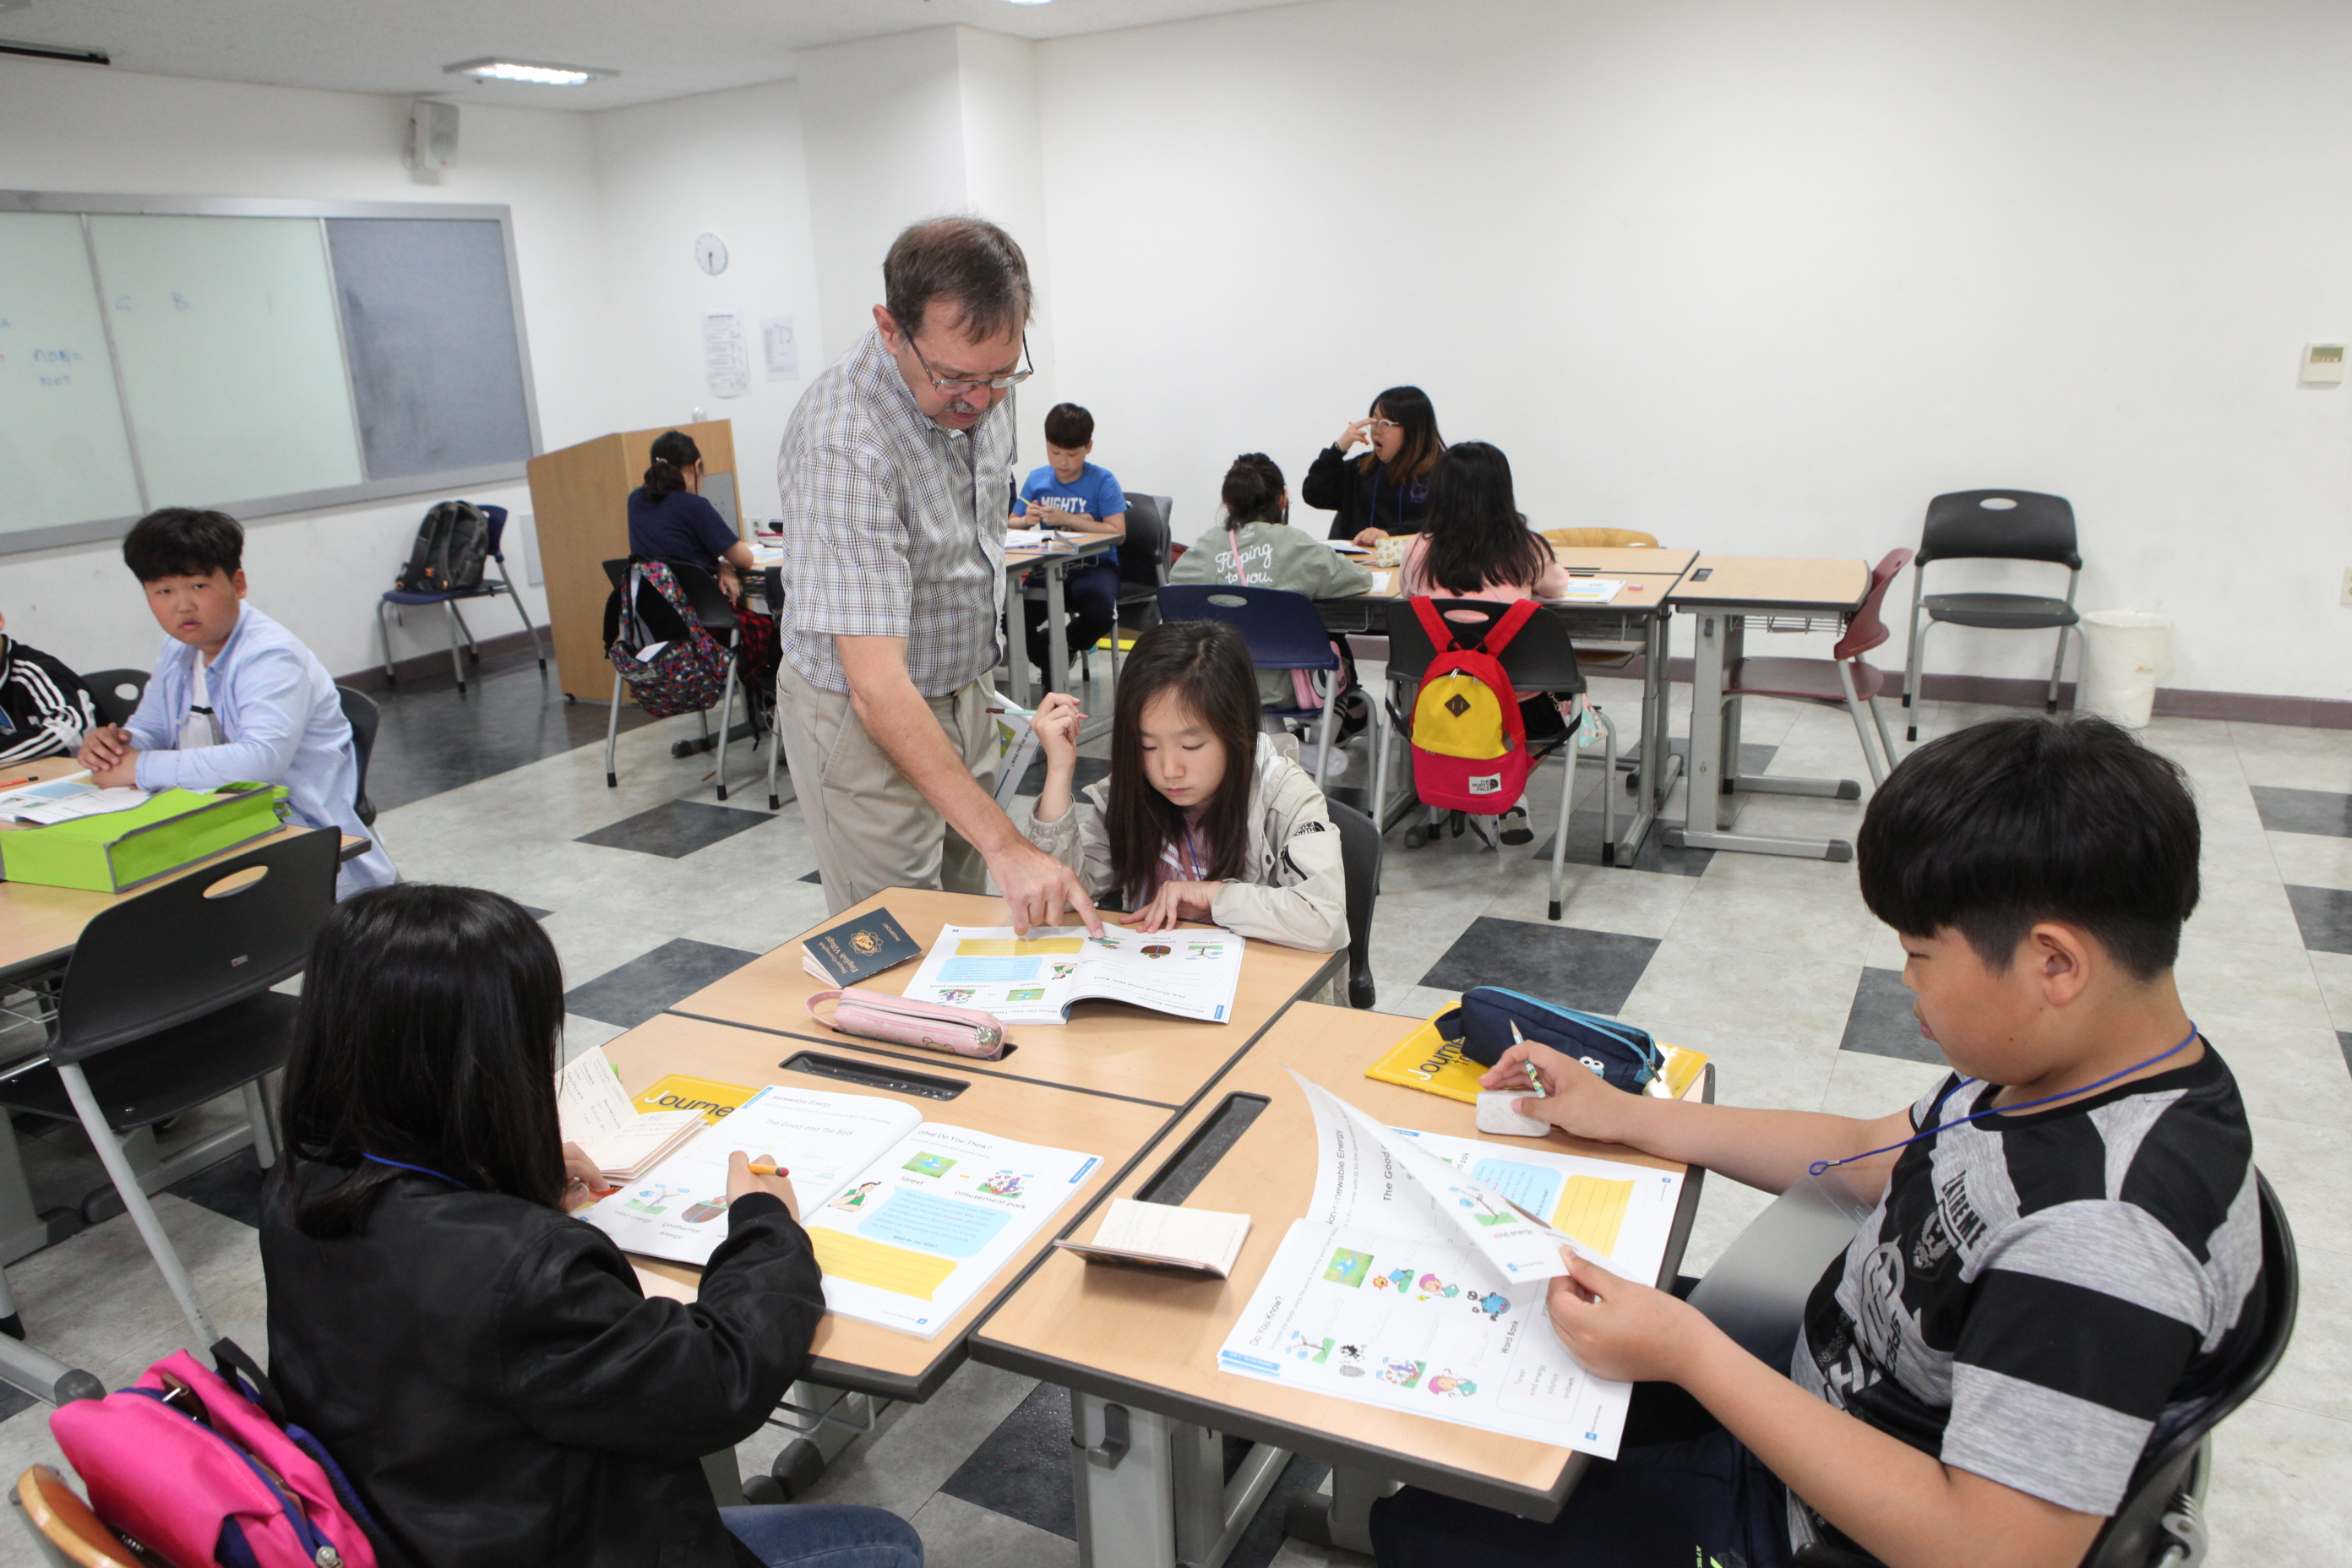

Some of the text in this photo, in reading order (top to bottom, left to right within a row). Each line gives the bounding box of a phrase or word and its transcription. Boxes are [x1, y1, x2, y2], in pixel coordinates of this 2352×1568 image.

[1041, 496, 1087, 513] MIGHTY
[1215, 543, 1273, 573] Hping
[1224, 571, 1239, 584] to
[882, 923, 901, 942] PASSPORT
[825, 935, 858, 973] English Village
[1407, 1036, 1467, 1081] Journe
[645, 1091, 736, 1117] Journe
[771, 1092, 807, 1106] Renewable
[808, 1099, 832, 1109] Energy
[780, 1120, 803, 1130] Good
[803, 1124, 819, 1133] and
[820, 1126, 836, 1135] The
[837, 1128, 854, 1137] Bad
[917, 1128, 937, 1138] What
[950, 1135, 965, 1144] You
[966, 1140, 993, 1152] Think?
[1336, 1129, 1345, 1159] Energy
[900, 1176, 924, 1186] forest
[1382, 1150, 1394, 1201] The Good
[955, 1190, 1027, 1211] amusement park
[1942, 1169, 1988, 1251] EXTREME
[614, 1210, 653, 1224] wind energy
[662, 1222, 702, 1234] geothermal
[659, 1231, 683, 1240] energy
[1250, 1295, 1282, 1346] Do You Know?
[1500, 1319, 1519, 1353] Word Bank
[1513, 1368, 1526, 1385] forest
[1527, 1364, 1546, 1396] wind energy
[1544, 1373, 1559, 1394] solution
[1560, 1375, 1575, 1398] problem
